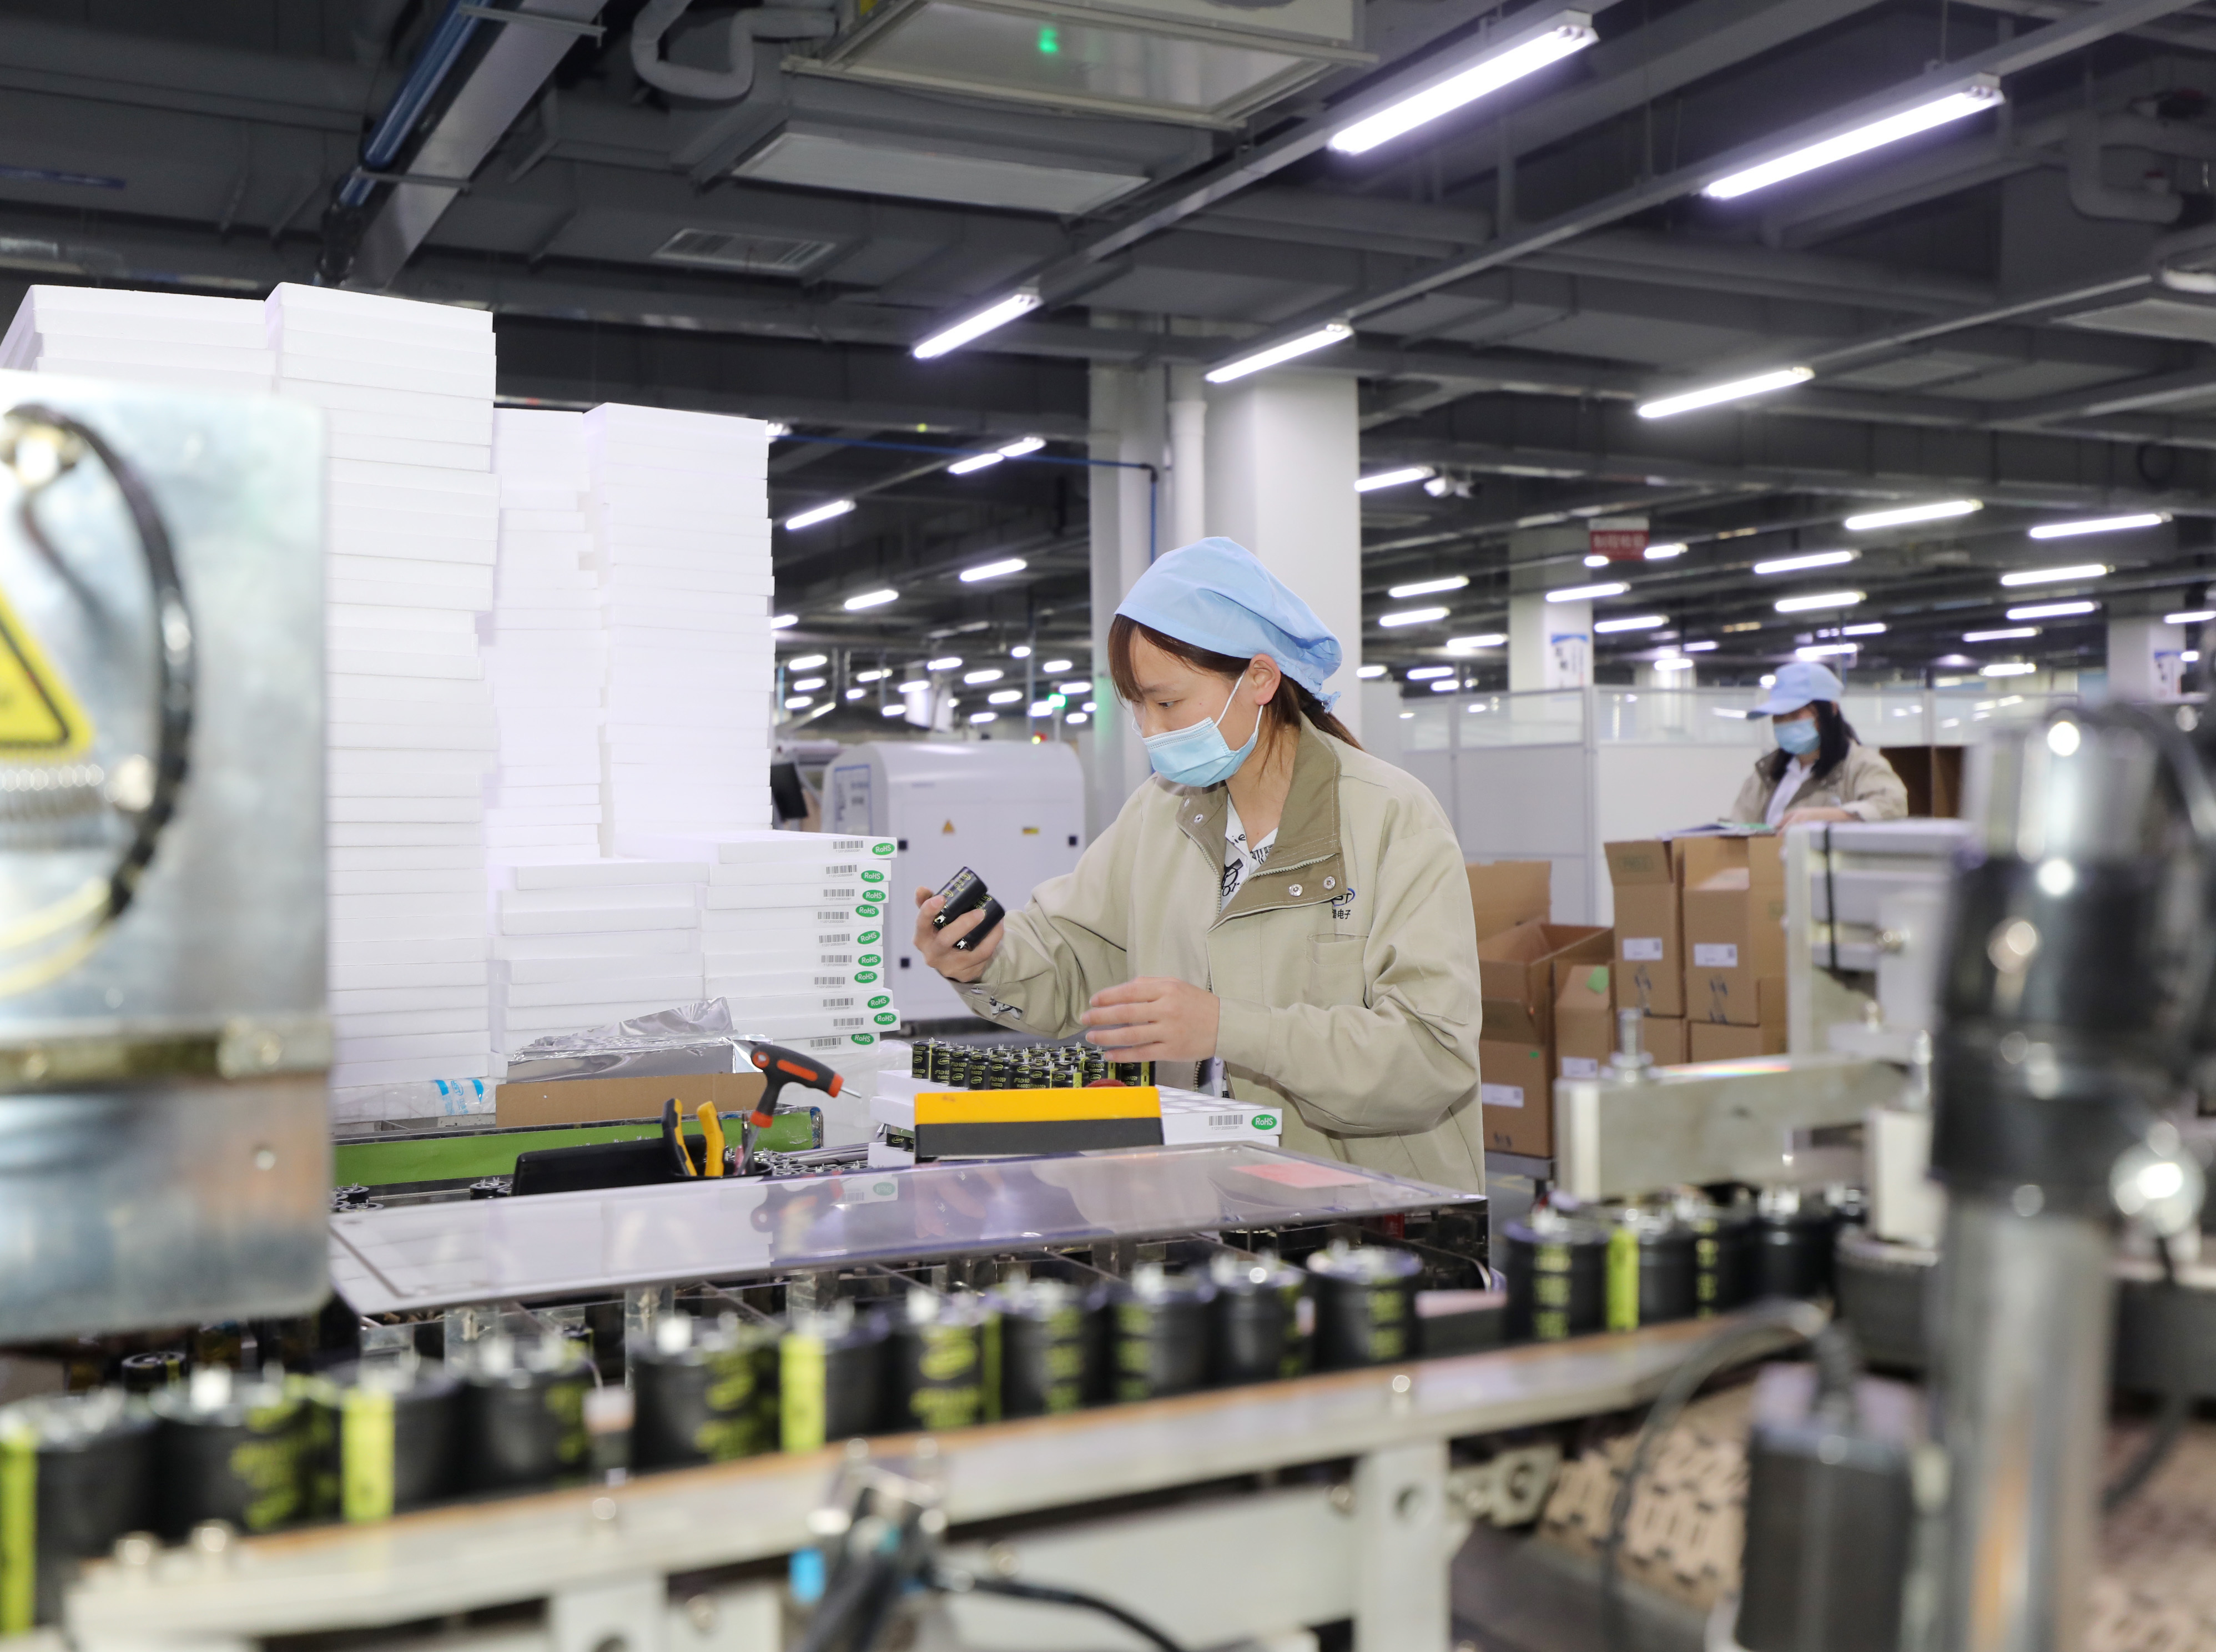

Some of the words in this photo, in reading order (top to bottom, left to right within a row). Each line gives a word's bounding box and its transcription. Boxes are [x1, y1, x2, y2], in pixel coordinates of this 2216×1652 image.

[875, 844, 892, 853] RoHS
[860, 932, 877, 942] RoHS
[870, 997, 887, 1006] RoHS
